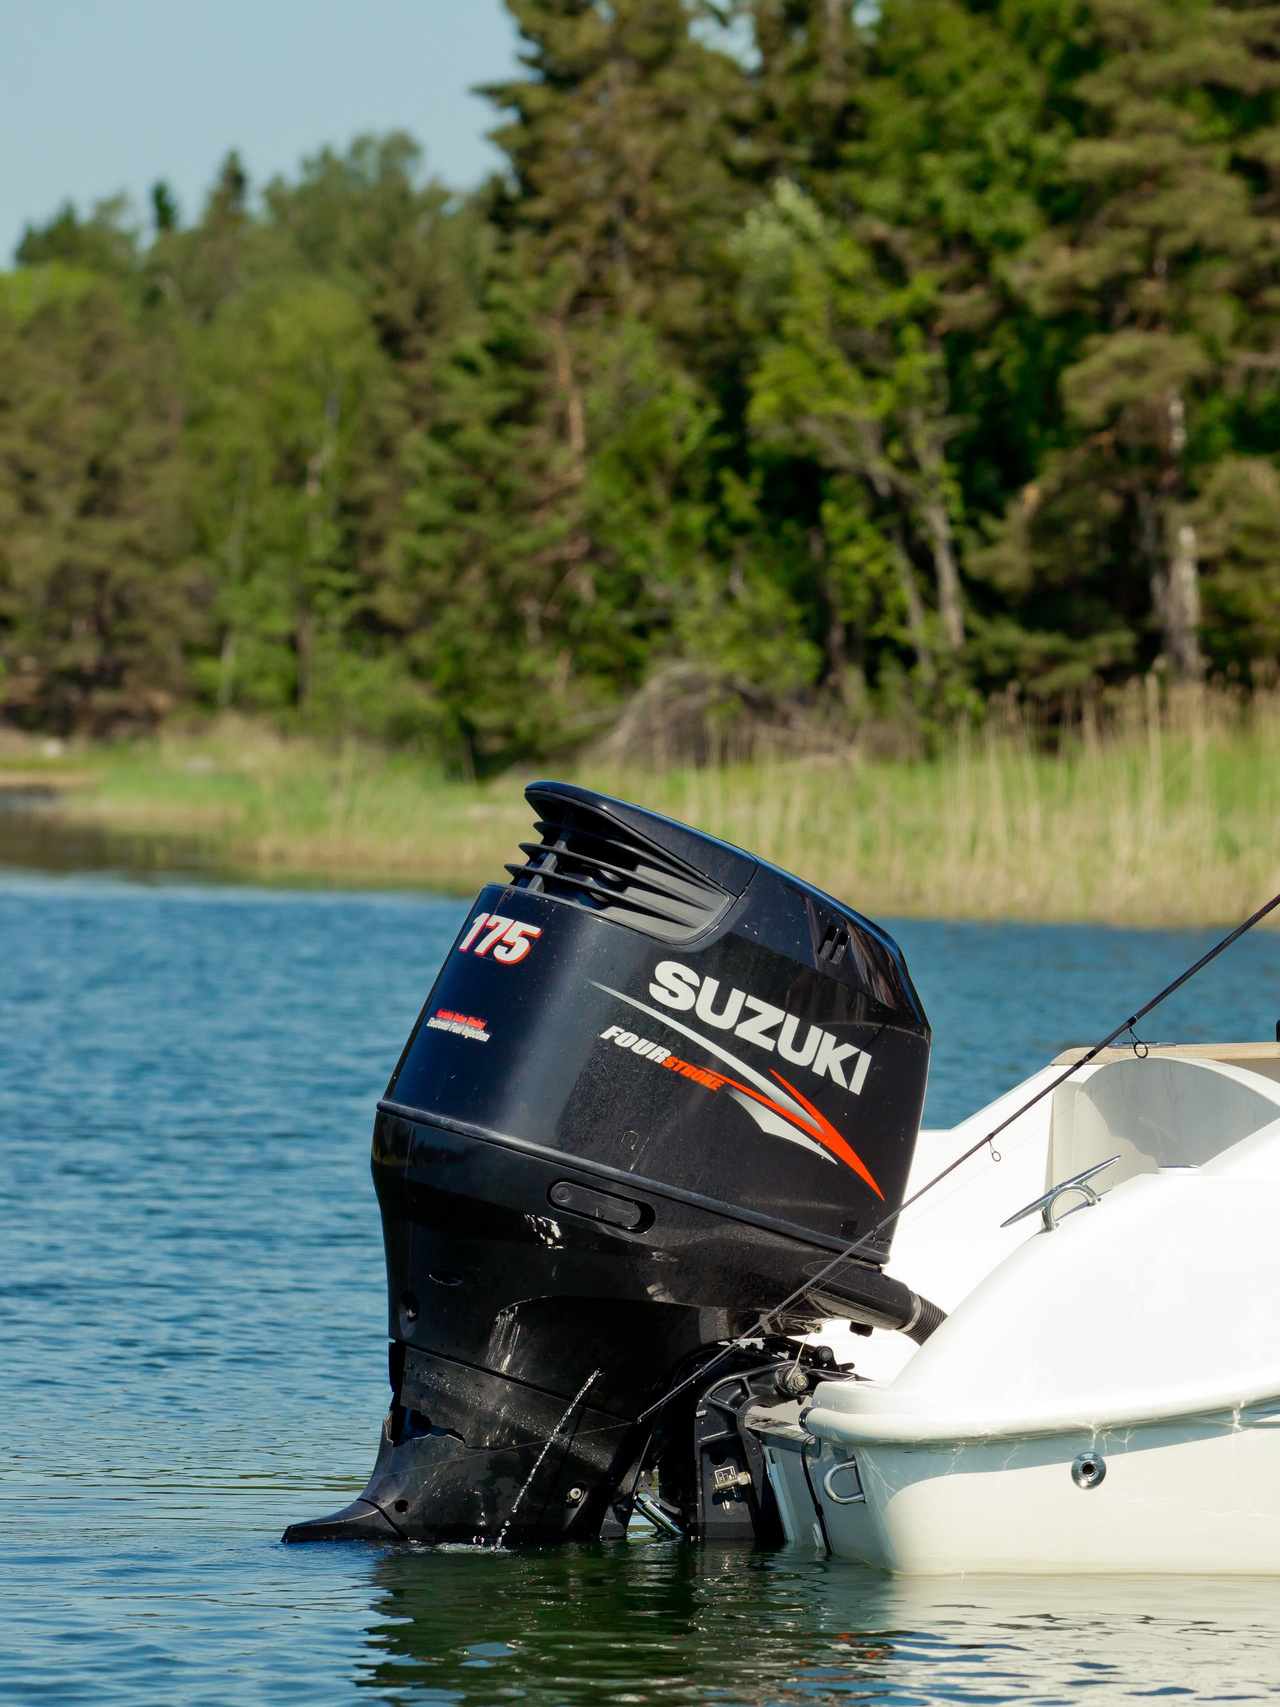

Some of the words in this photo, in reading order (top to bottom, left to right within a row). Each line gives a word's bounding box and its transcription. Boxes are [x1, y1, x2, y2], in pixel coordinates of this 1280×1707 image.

[459, 912, 543, 965] 175
[426, 1017, 451, 1031] Electronic
[449, 1022, 465, 1035] Fuel
[461, 1025, 490, 1042] Injection
[648, 960, 872, 1096] SUZUKI
